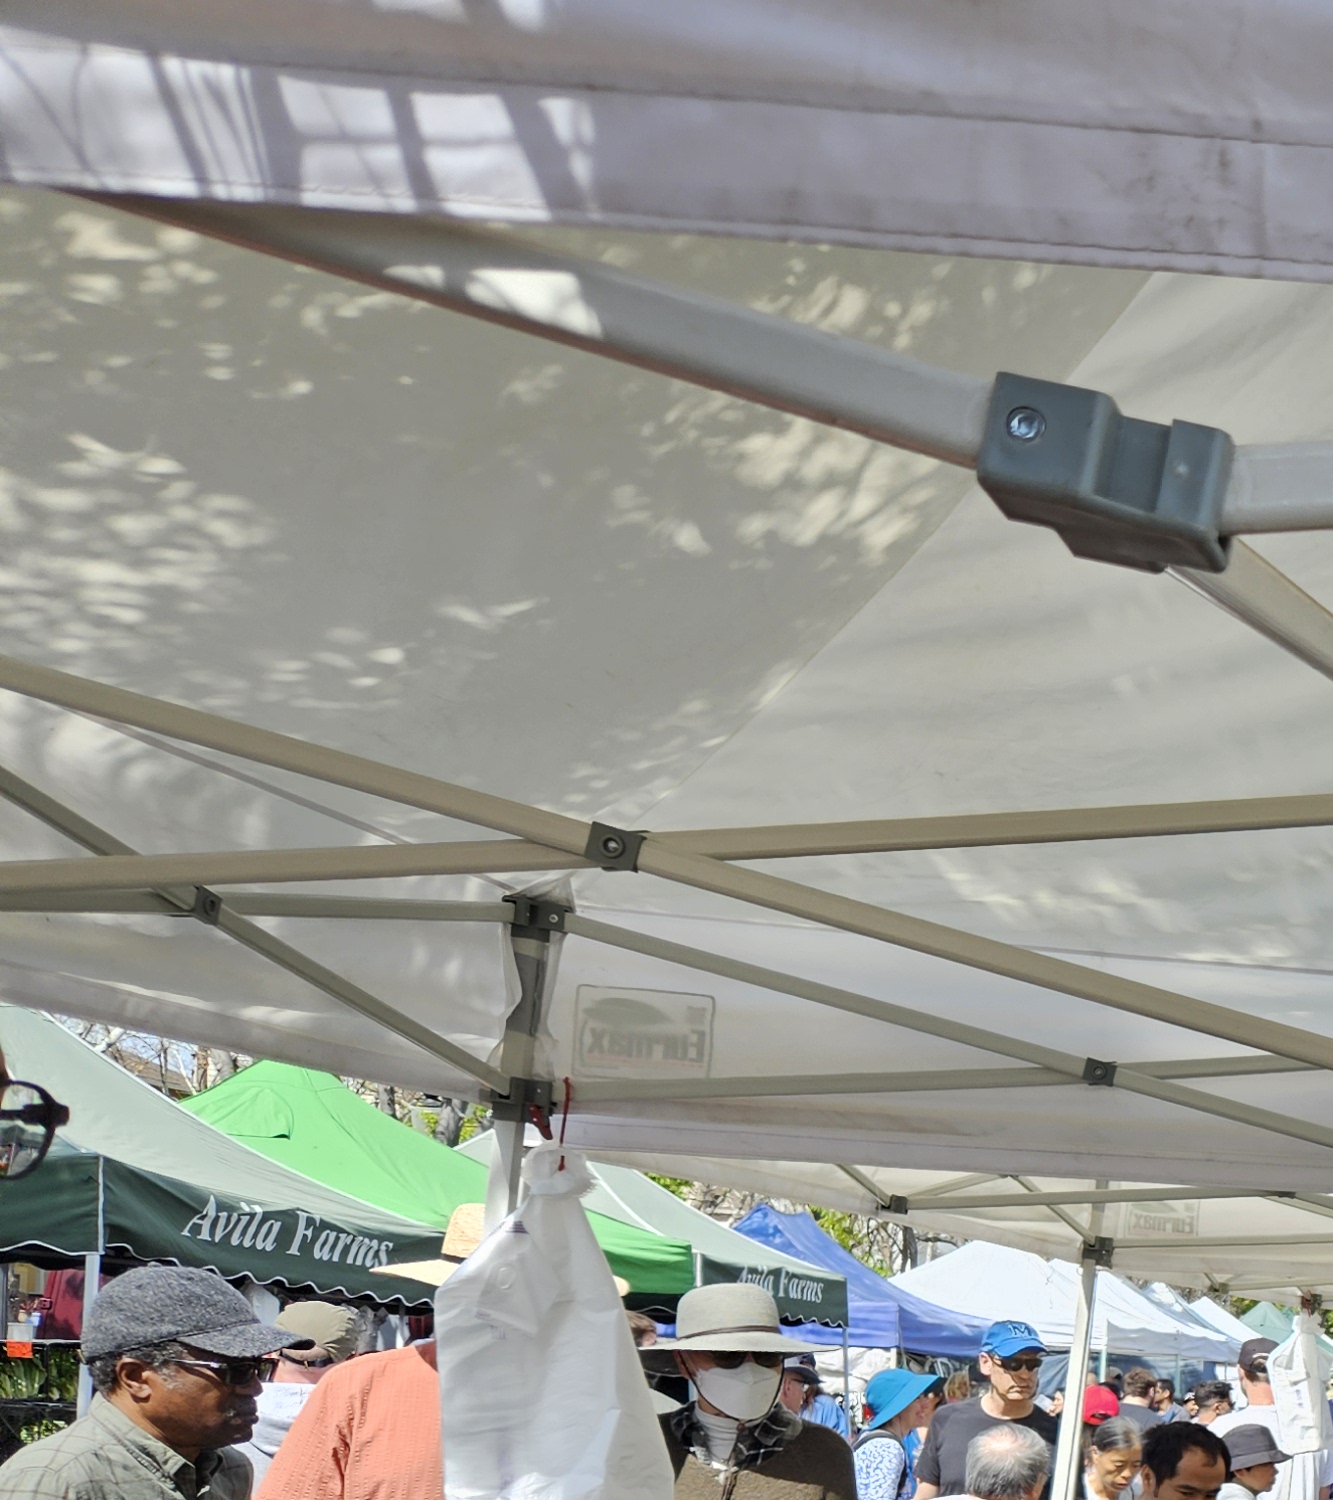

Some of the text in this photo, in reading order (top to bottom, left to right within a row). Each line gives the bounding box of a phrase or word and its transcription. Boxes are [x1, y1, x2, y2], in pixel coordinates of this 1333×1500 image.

[181, 1194, 394, 1268] Avila Farms
[777, 1266, 825, 1303] Farms
